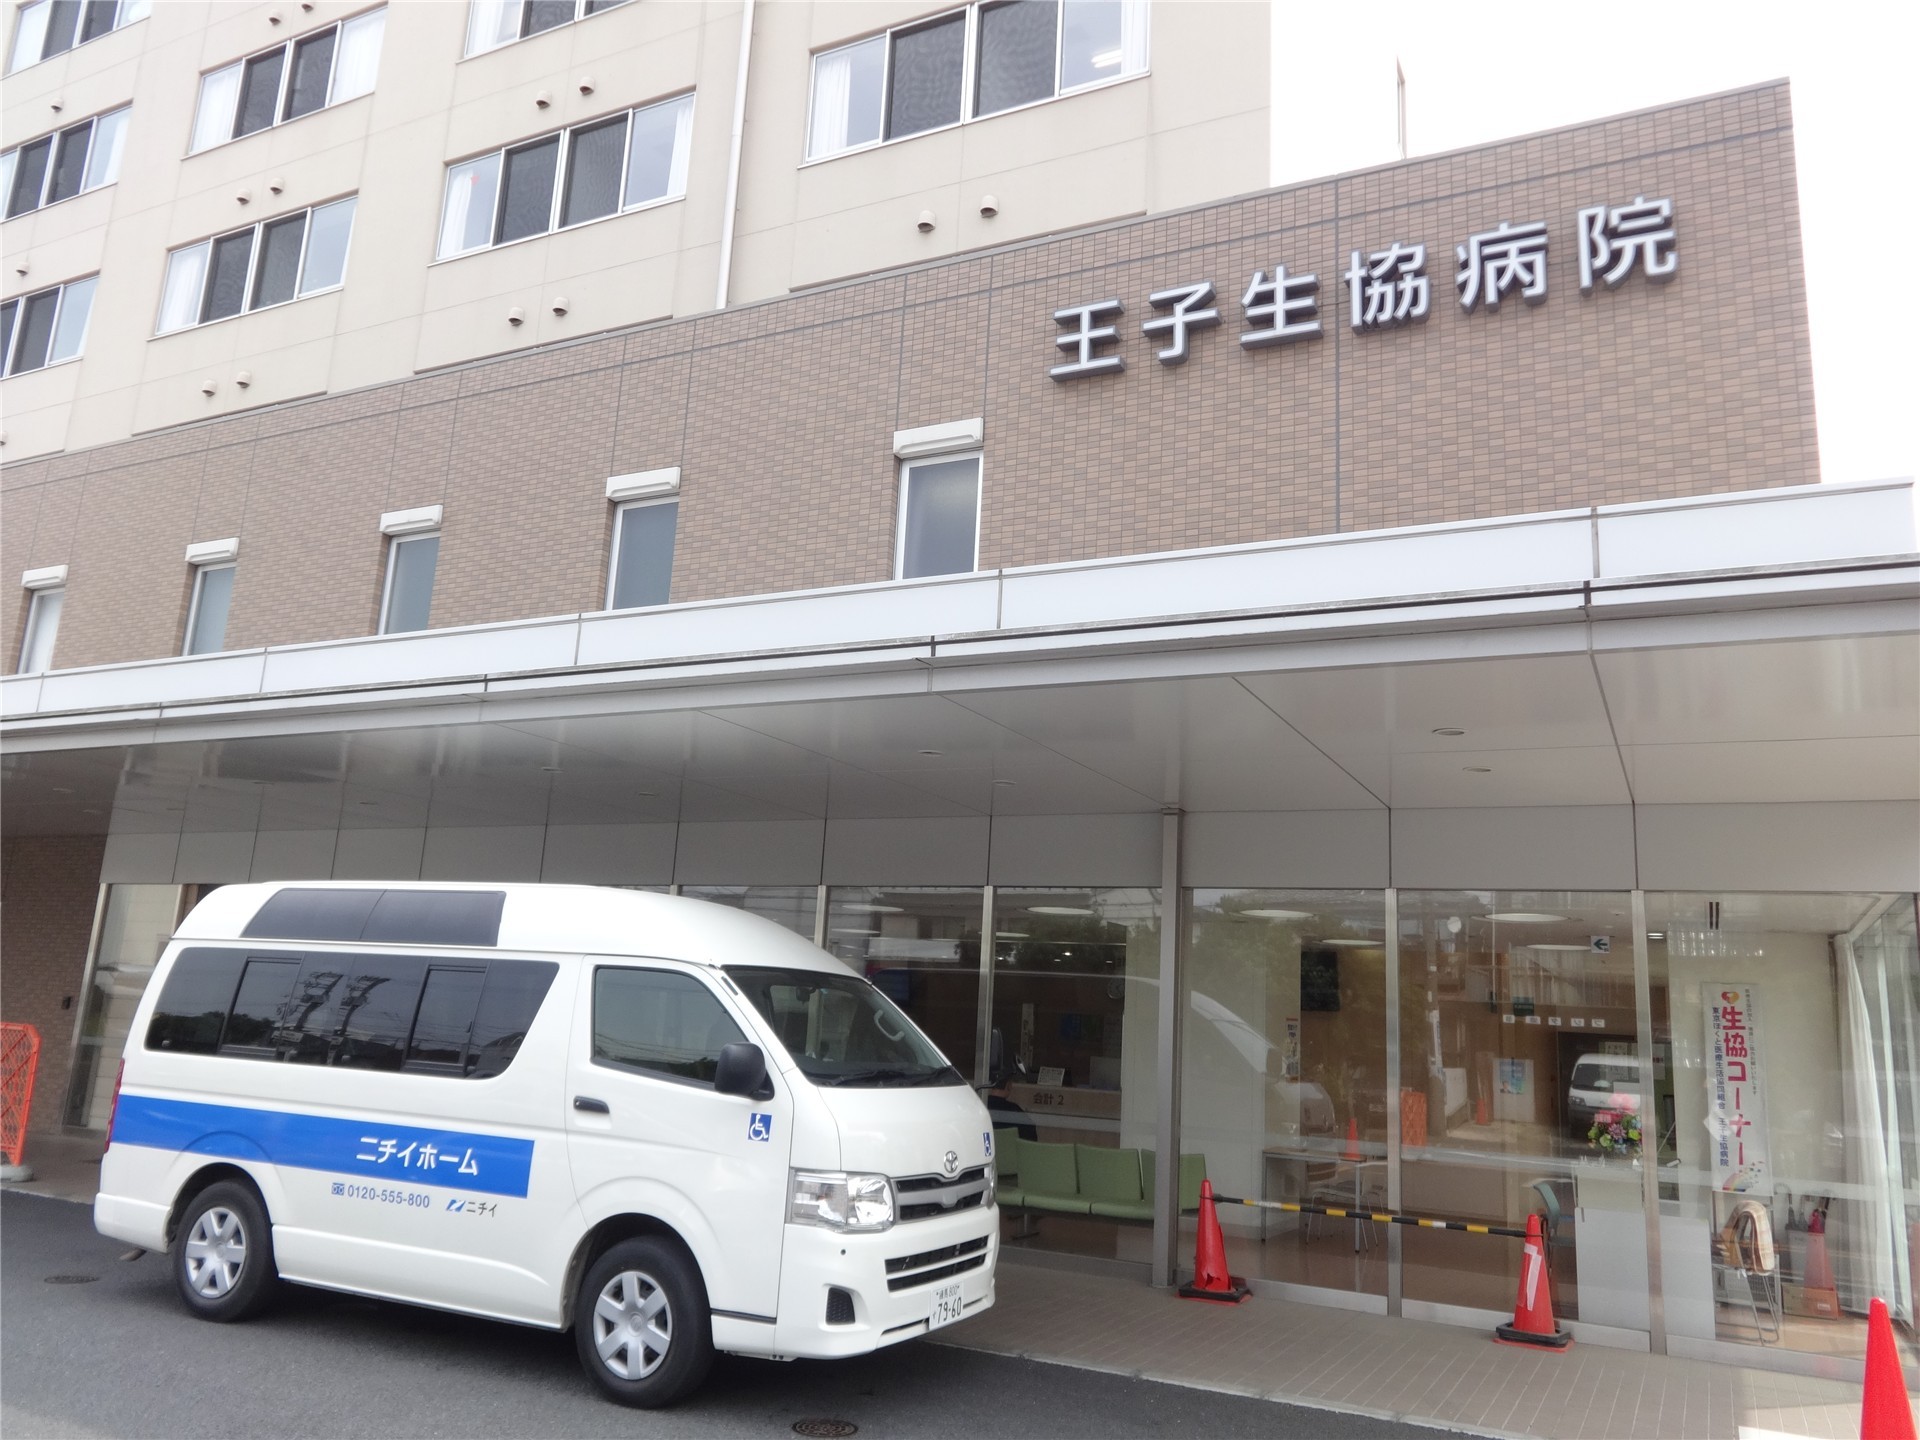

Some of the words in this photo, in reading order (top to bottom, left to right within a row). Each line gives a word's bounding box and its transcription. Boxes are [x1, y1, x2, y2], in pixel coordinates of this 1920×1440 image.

[1049, 196, 1678, 382] 王子生協病院
[1721, 1005, 1752, 1166] 生協コーナー
[356, 1136, 479, 1176] ニチイホーム
[347, 1184, 430, 1209] 0120-555-800
[466, 1201, 498, 1218] ニチイ
[938, 1296, 962, 1324] 79-60
